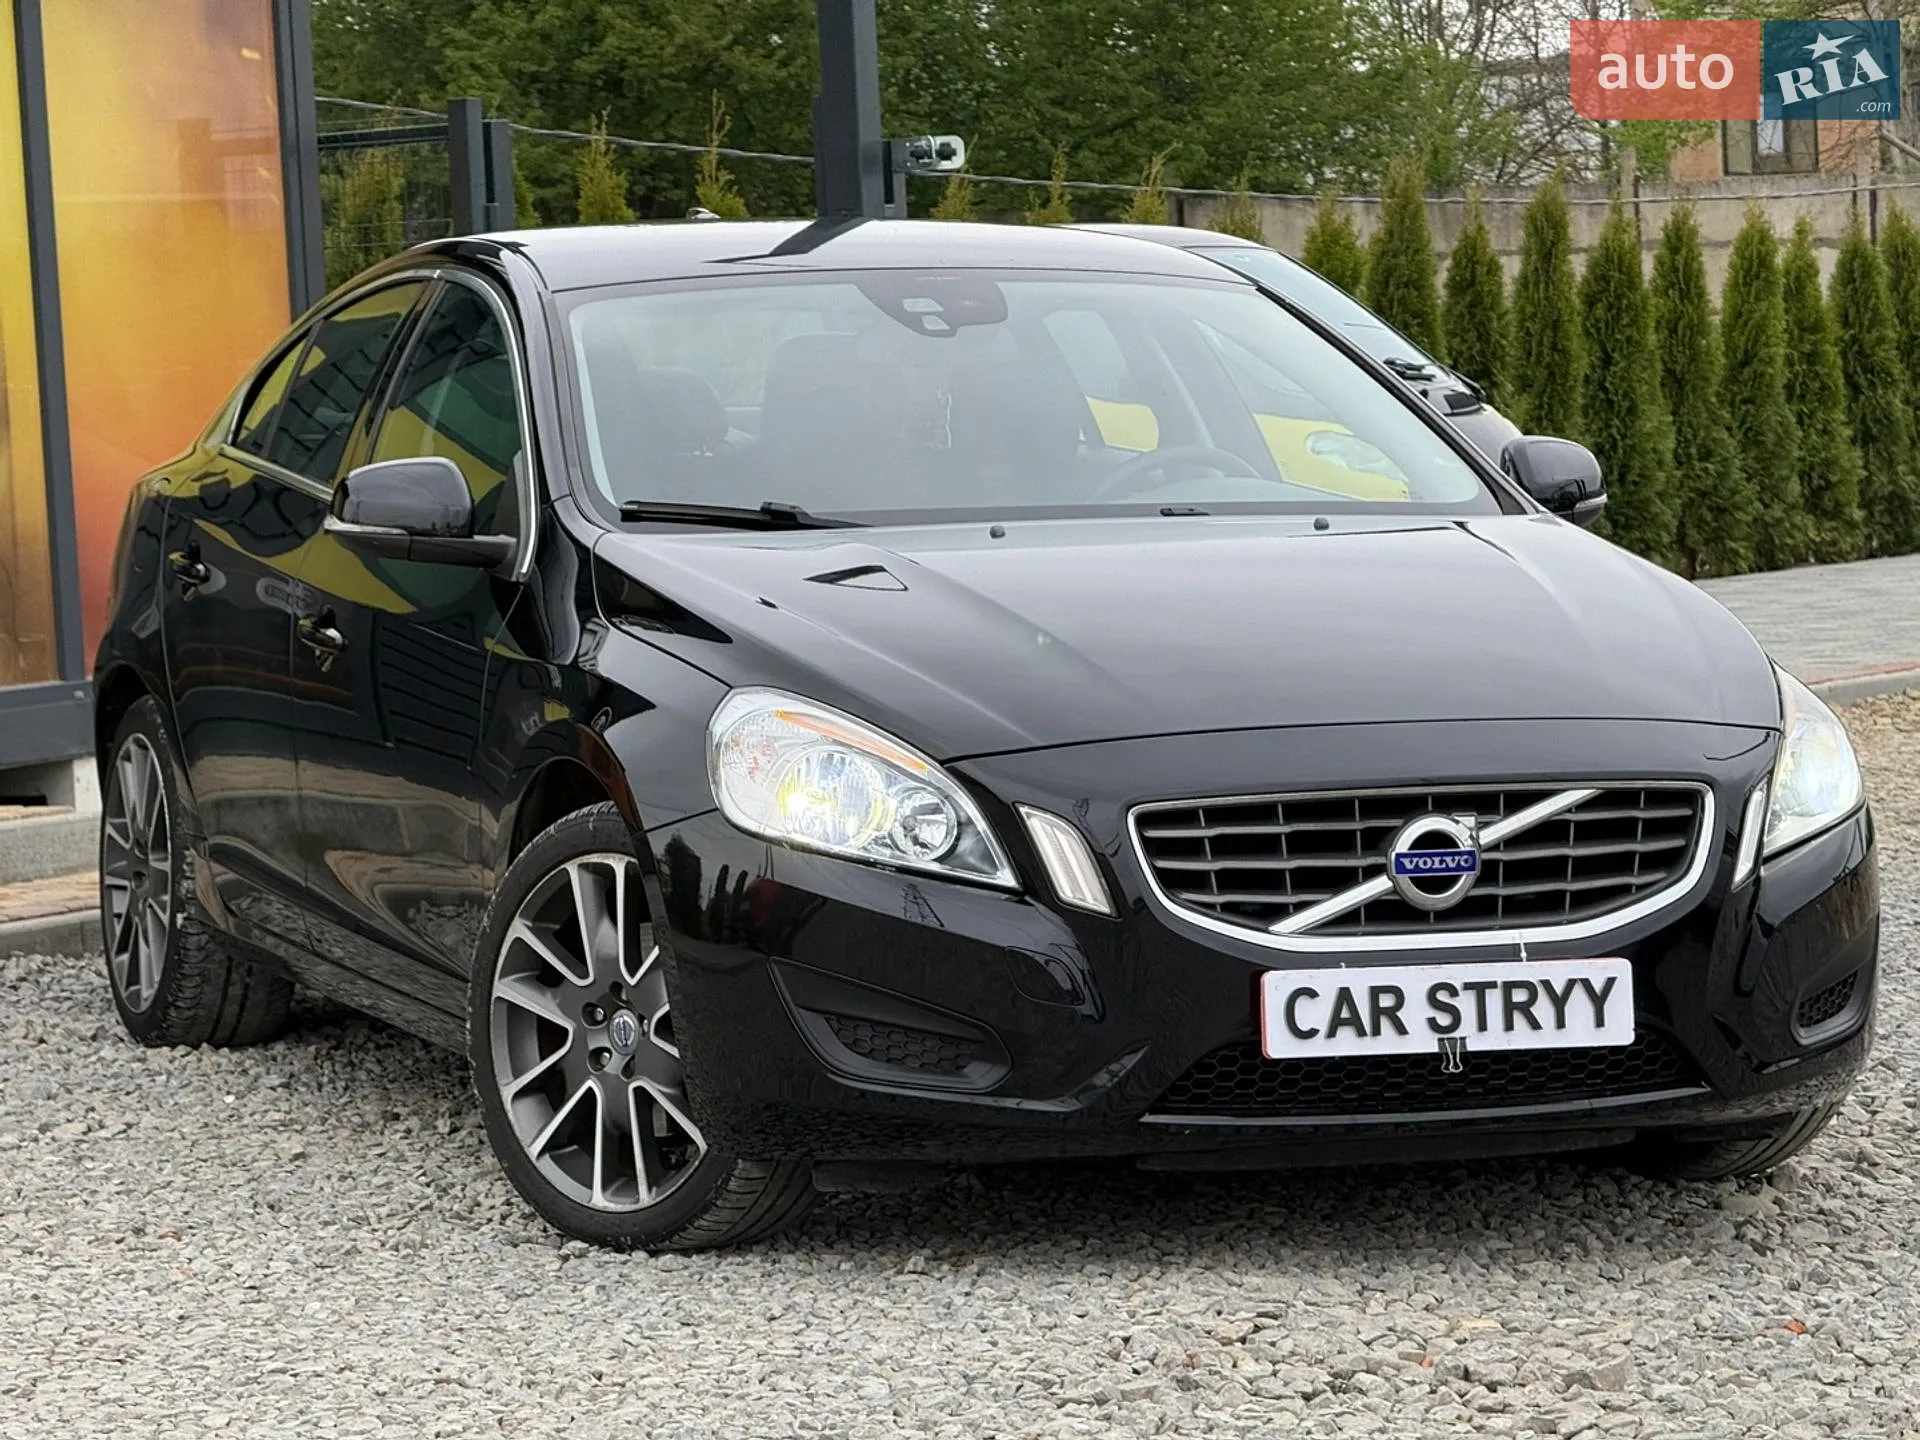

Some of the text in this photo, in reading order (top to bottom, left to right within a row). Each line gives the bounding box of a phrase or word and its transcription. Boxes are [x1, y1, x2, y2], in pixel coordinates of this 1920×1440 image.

[1400, 855, 1473, 870] VOLVO
[1283, 976, 1618, 1040] CAR STRYY
